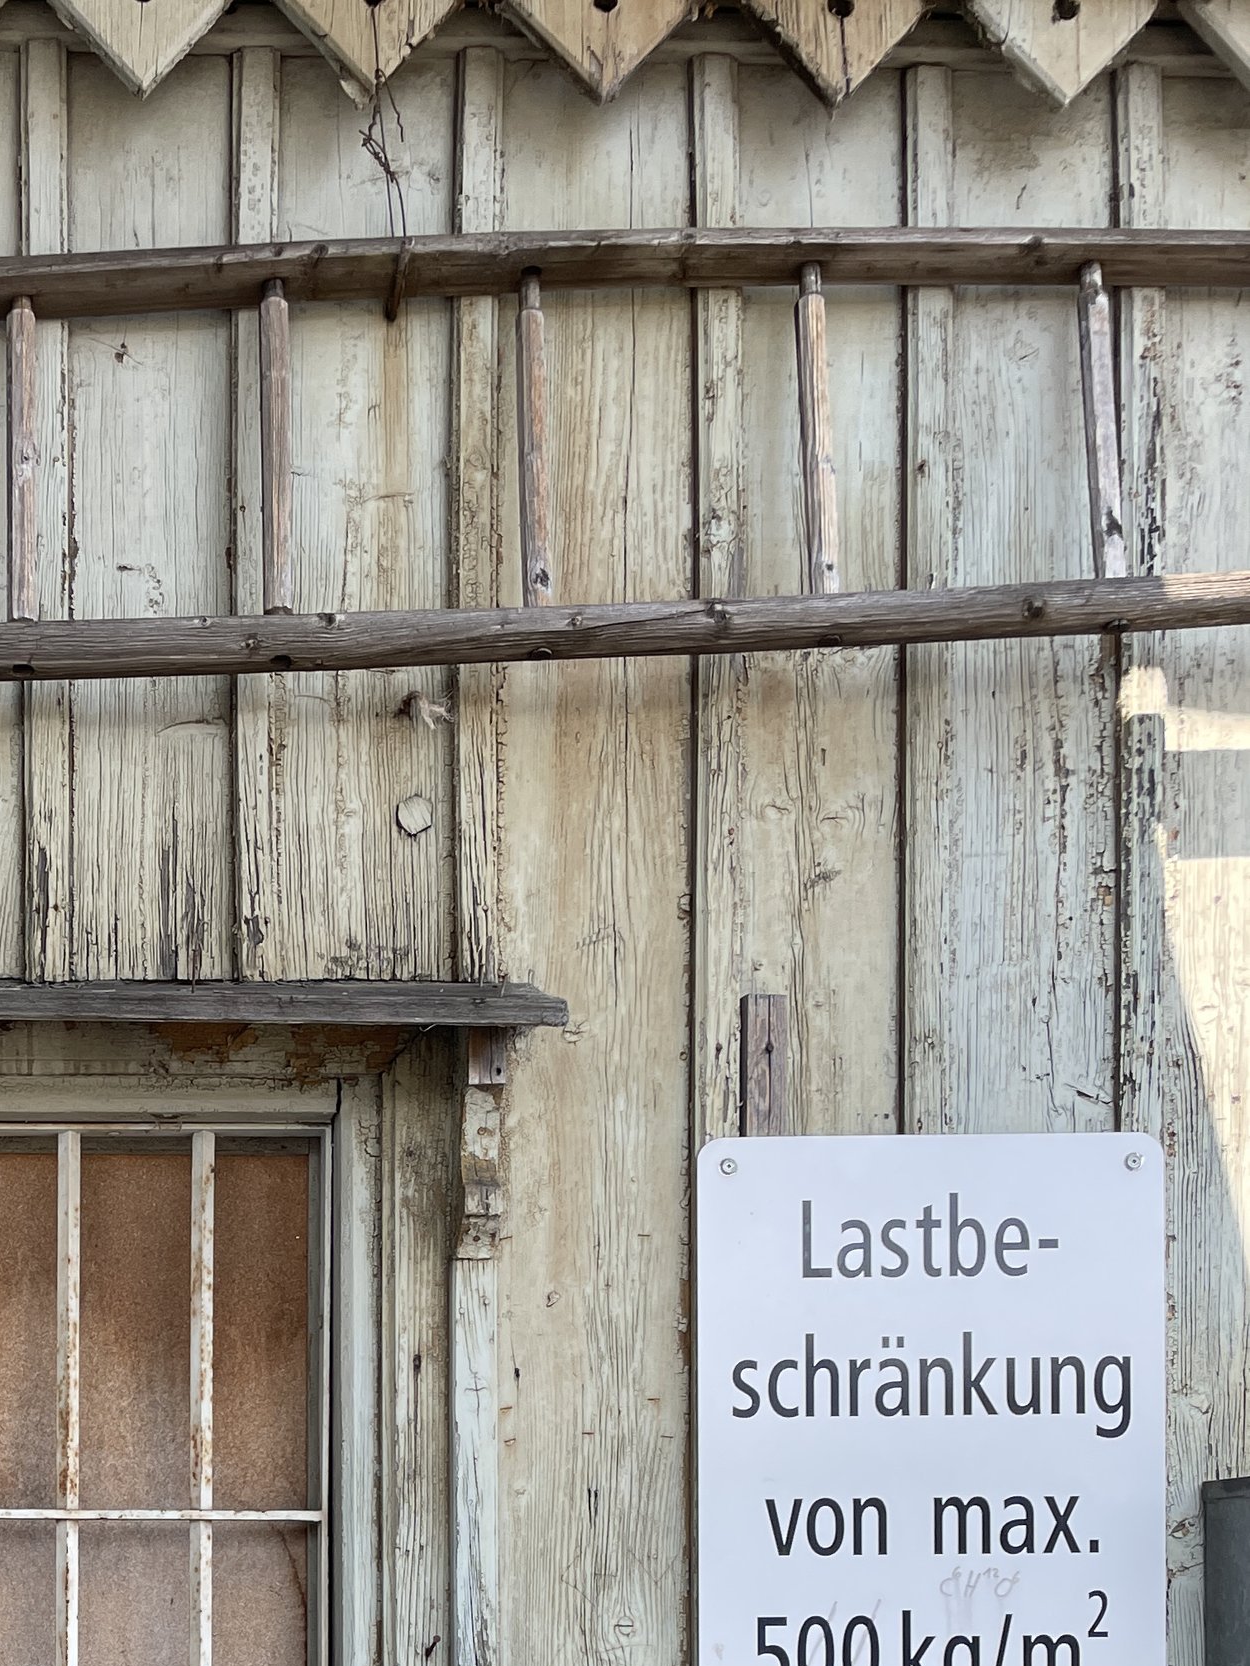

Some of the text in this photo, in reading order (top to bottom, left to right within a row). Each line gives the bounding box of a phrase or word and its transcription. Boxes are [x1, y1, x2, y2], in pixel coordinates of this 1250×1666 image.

[801, 1192, 1060, 1280] Lastbe-
[730, 1330, 1132, 1440] schränkung
[764, 1494, 1101, 1557] von max.
